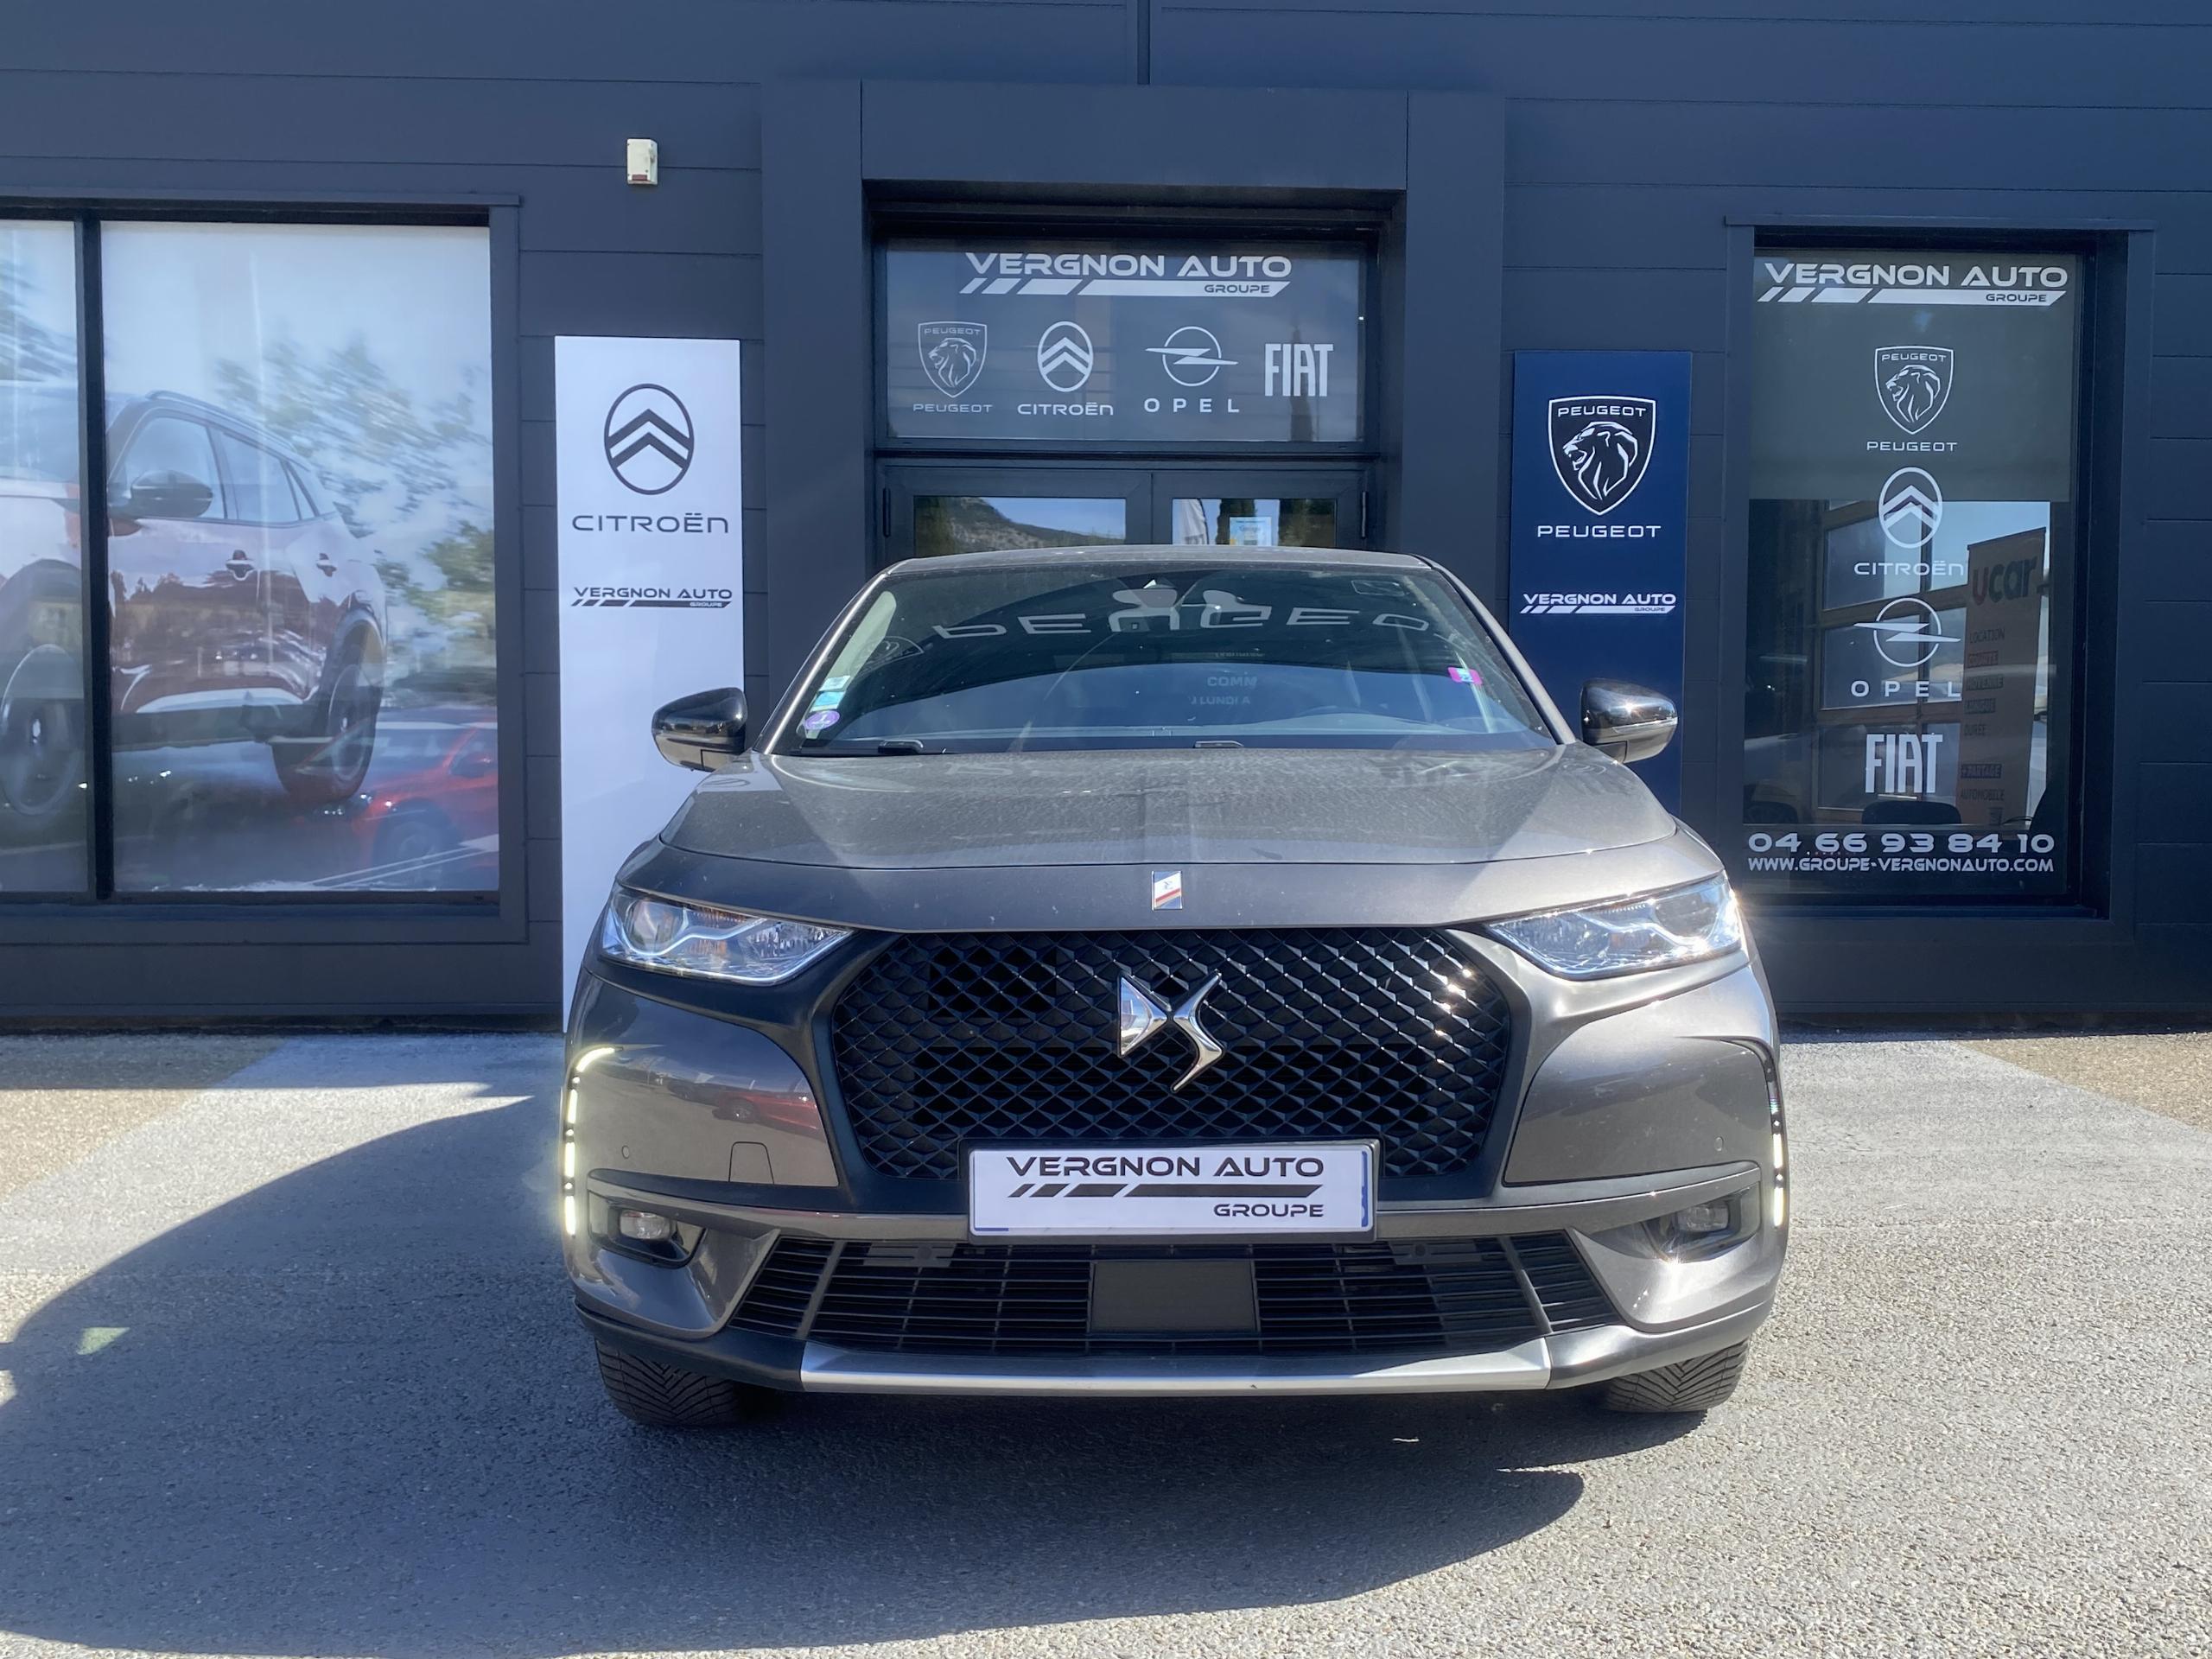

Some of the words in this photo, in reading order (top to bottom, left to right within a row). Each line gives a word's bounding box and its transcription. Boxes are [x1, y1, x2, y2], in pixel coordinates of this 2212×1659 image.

[965, 252, 1165, 277] VERGNON
[1176, 255, 1292, 278] AUTO
[1764, 263, 1949, 286] VERGNON
[1960, 265, 2068, 288] AUTO
[1204, 284, 1270, 294] GROUPE
[1986, 293, 2047, 302] GROUPE
[924, 327, 981, 336] PEUGEOT
[1881, 353, 1947, 362] PEUGEOT
[1264, 343, 1334, 397] FIAT
[912, 403, 993, 413] PEUGEOT
[1017, 401, 1114, 416] CITROËN
[1144, 397, 1240, 413] OPEL
[1557, 405, 1647, 417] PEUGEOT
[1866, 441, 1957, 452] PEUGEOT
[572, 512, 728, 533] CITROËN
[1537, 525, 1662, 537] PEUGEOT
[1853, 559, 1964, 576] CITROËN
[1971, 557, 2037, 606] ucar
[574, 587, 671, 599] VERGNON
[677, 588, 733, 599] AUTO
[1522, 594, 1617, 605] VERGNON
[1621, 594, 1676, 605] AUTO
[1850, 680, 1962, 698] OPEL
[1865, 733, 1943, 794] FIAT
[1748, 832, 1802, 853] 04
[1815, 833, 1867, 853] 66
[1880, 833, 1935, 853] 93
[1948, 833, 2003, 853] 84
[2016, 833, 2055, 854] 10
[1747, 857, 2054, 873] WWW.GROUPE-VERGNONAUTO.COM
[1006, 1156, 1200, 1177] VERGNON
[1213, 1157, 1324, 1178] AUTO
[1213, 1204, 1324, 1217] GROUPE
